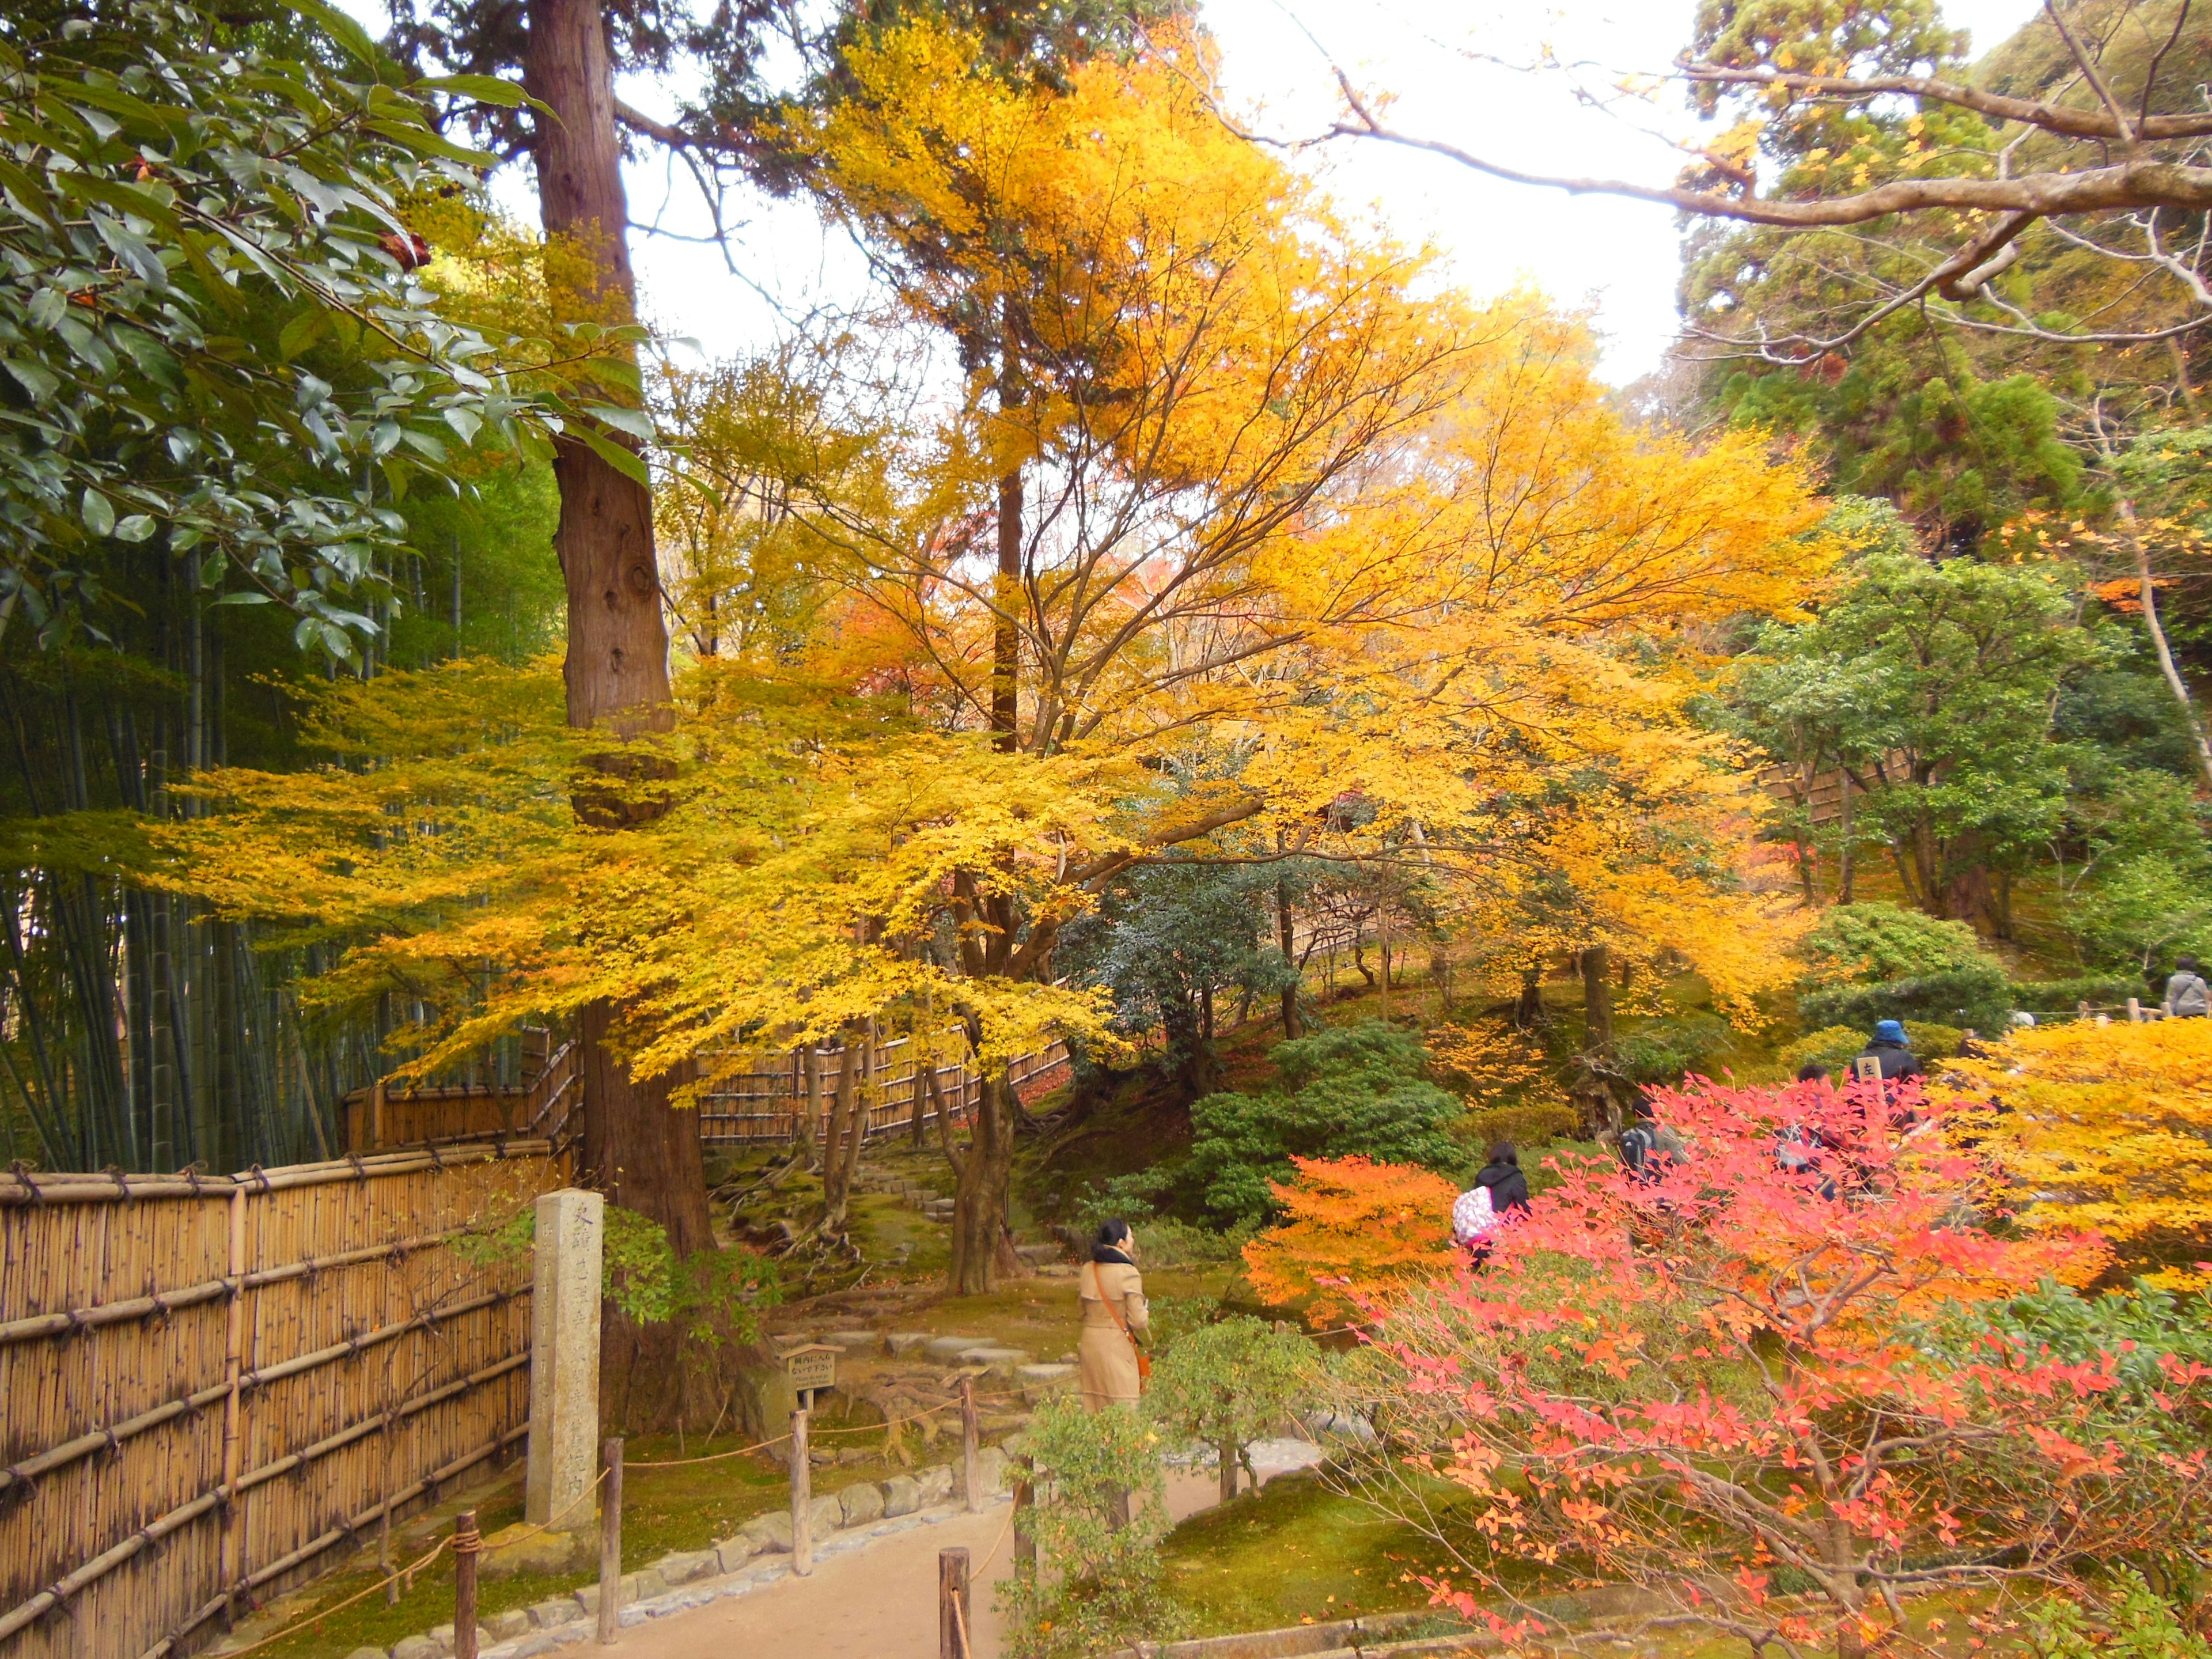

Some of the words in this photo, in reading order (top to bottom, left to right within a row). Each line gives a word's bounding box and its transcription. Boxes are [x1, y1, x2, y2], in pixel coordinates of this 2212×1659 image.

[791, 1363, 832, 1375] ないで下さい
